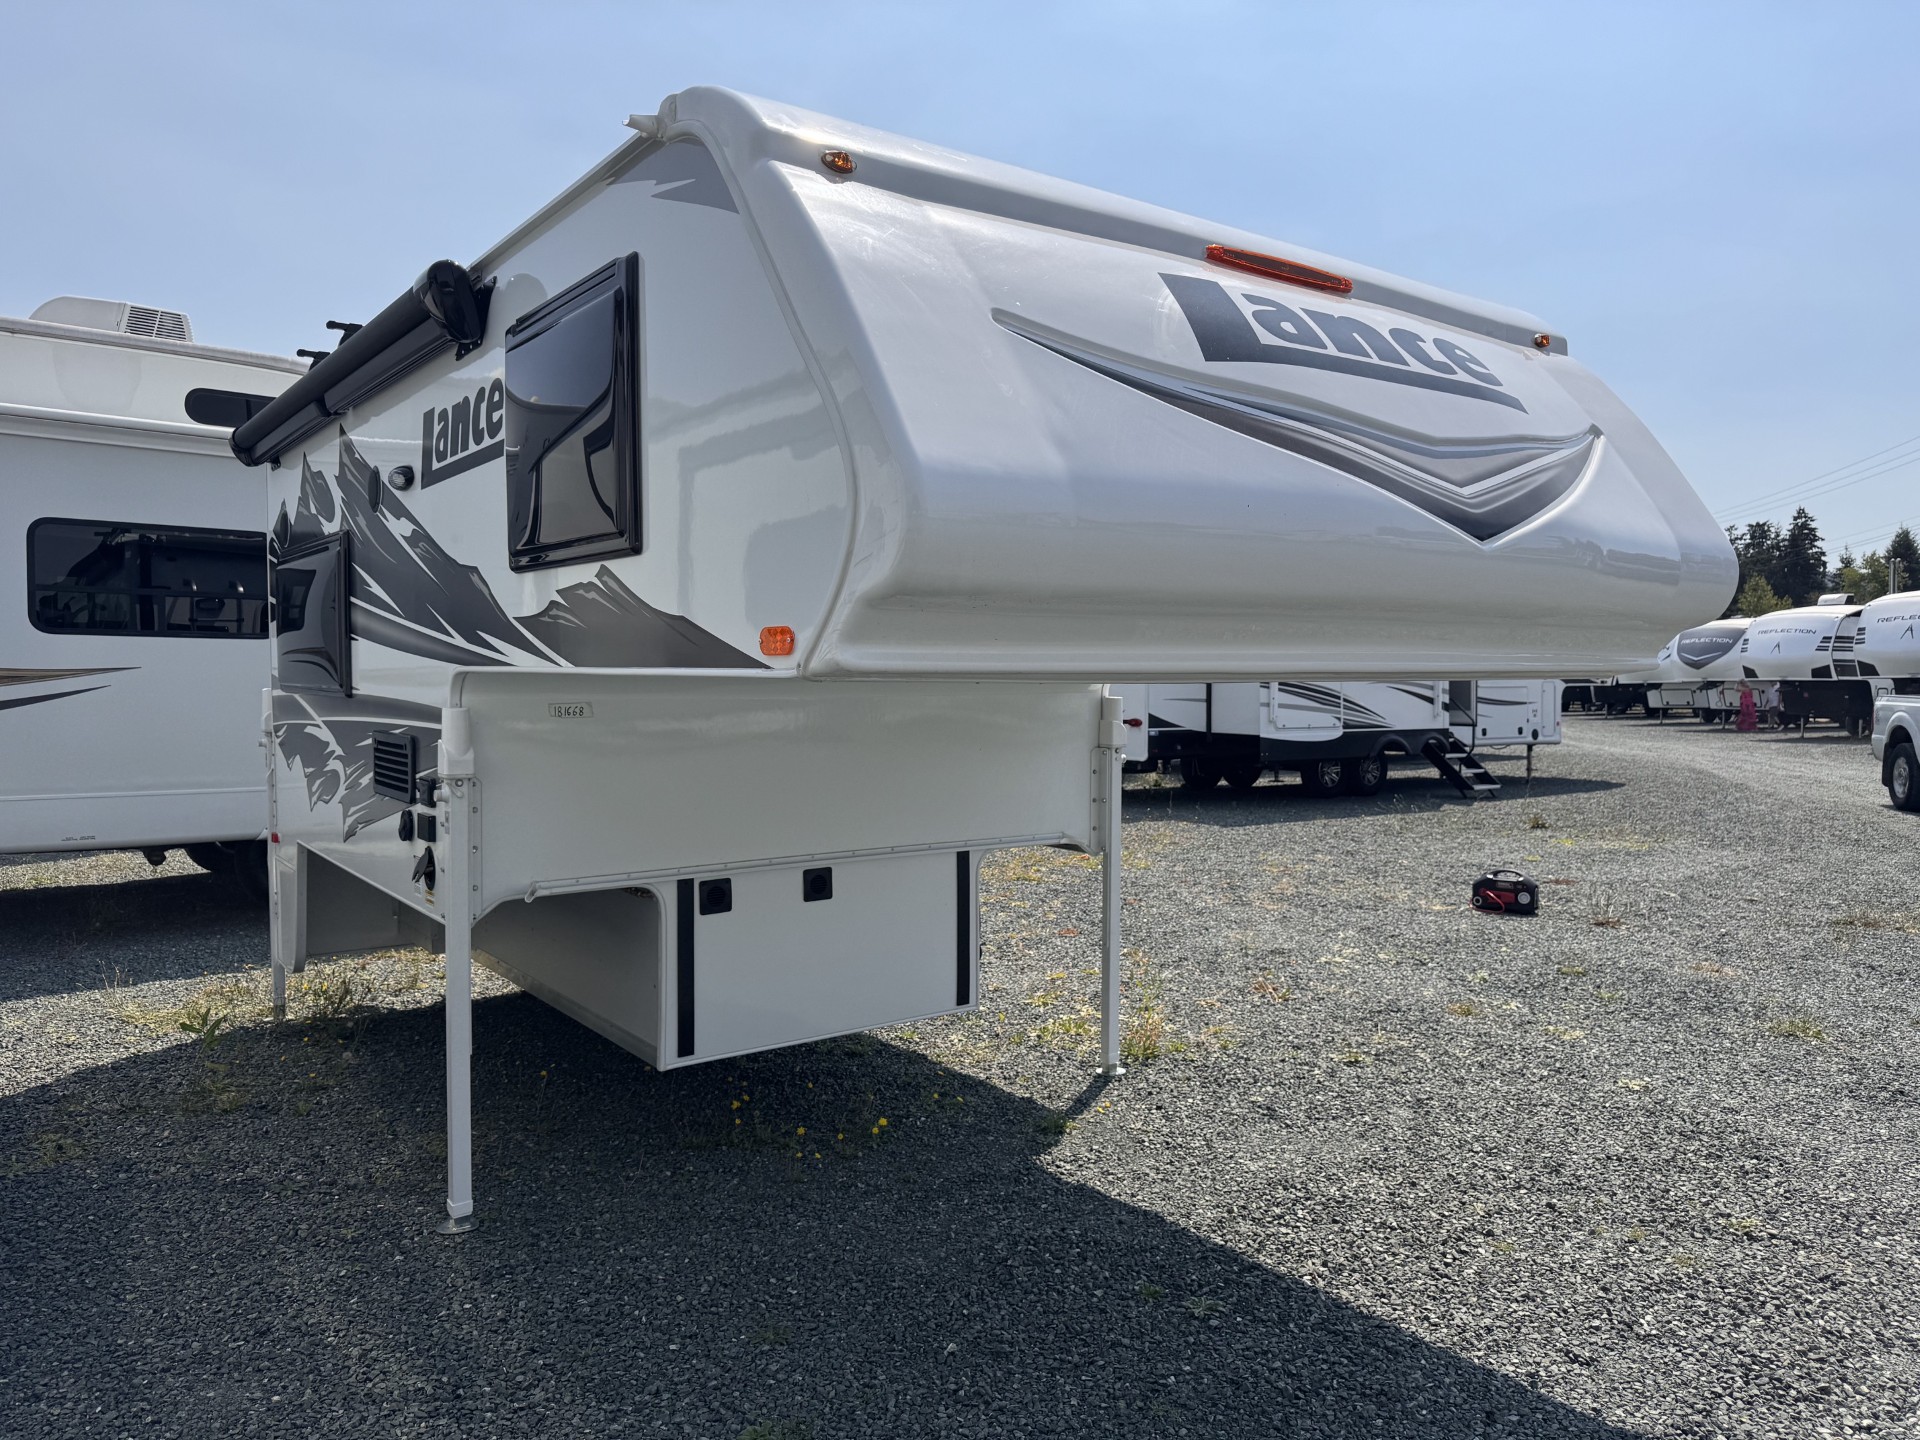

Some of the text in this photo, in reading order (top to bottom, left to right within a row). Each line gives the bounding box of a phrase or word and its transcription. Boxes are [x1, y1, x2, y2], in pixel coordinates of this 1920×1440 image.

[1157, 272, 1529, 415] Lance
[421, 377, 505, 491] Lance
[1757, 627, 1817, 635] REFLECTION
[1681, 637, 1733, 645] REFLECTION
[553, 705, 584, 718] 181668
